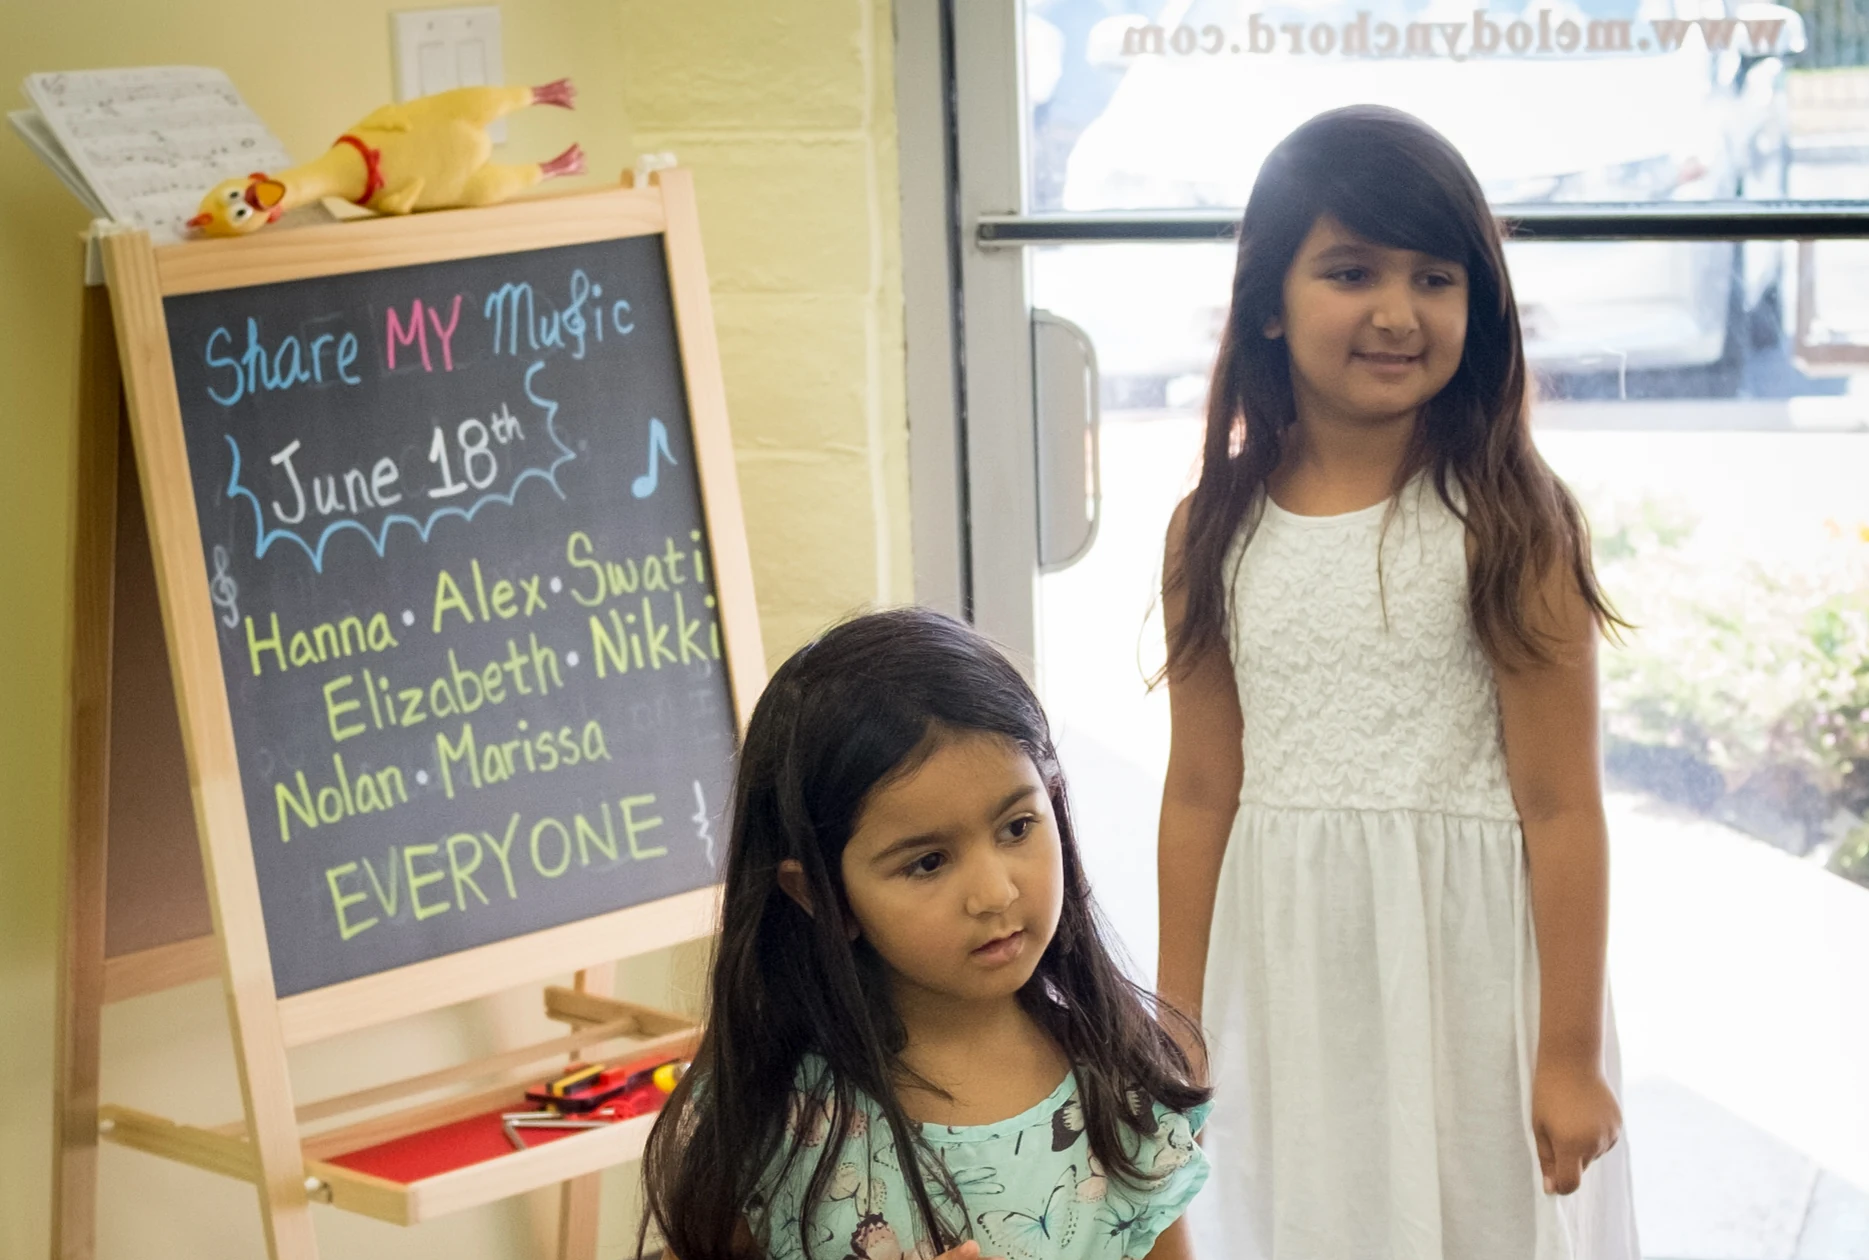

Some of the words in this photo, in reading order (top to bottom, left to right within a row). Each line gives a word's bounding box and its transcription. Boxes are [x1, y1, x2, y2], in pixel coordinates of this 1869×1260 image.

[206, 317, 362, 405] Share
[386, 295, 463, 372] MY
[270, 440, 402, 524] June
[428, 403, 525, 499] 18th
[245, 611, 398, 676] Hanna
[432, 558, 548, 633] Alex
[566, 530, 706, 607] Swati
[323, 633, 564, 742] Elizabeth
[590, 591, 721, 678] Nikki
[275, 753, 407, 842] Nolan
[437, 720, 612, 799] Marissa
[326, 794, 668, 940] EVERYONE
